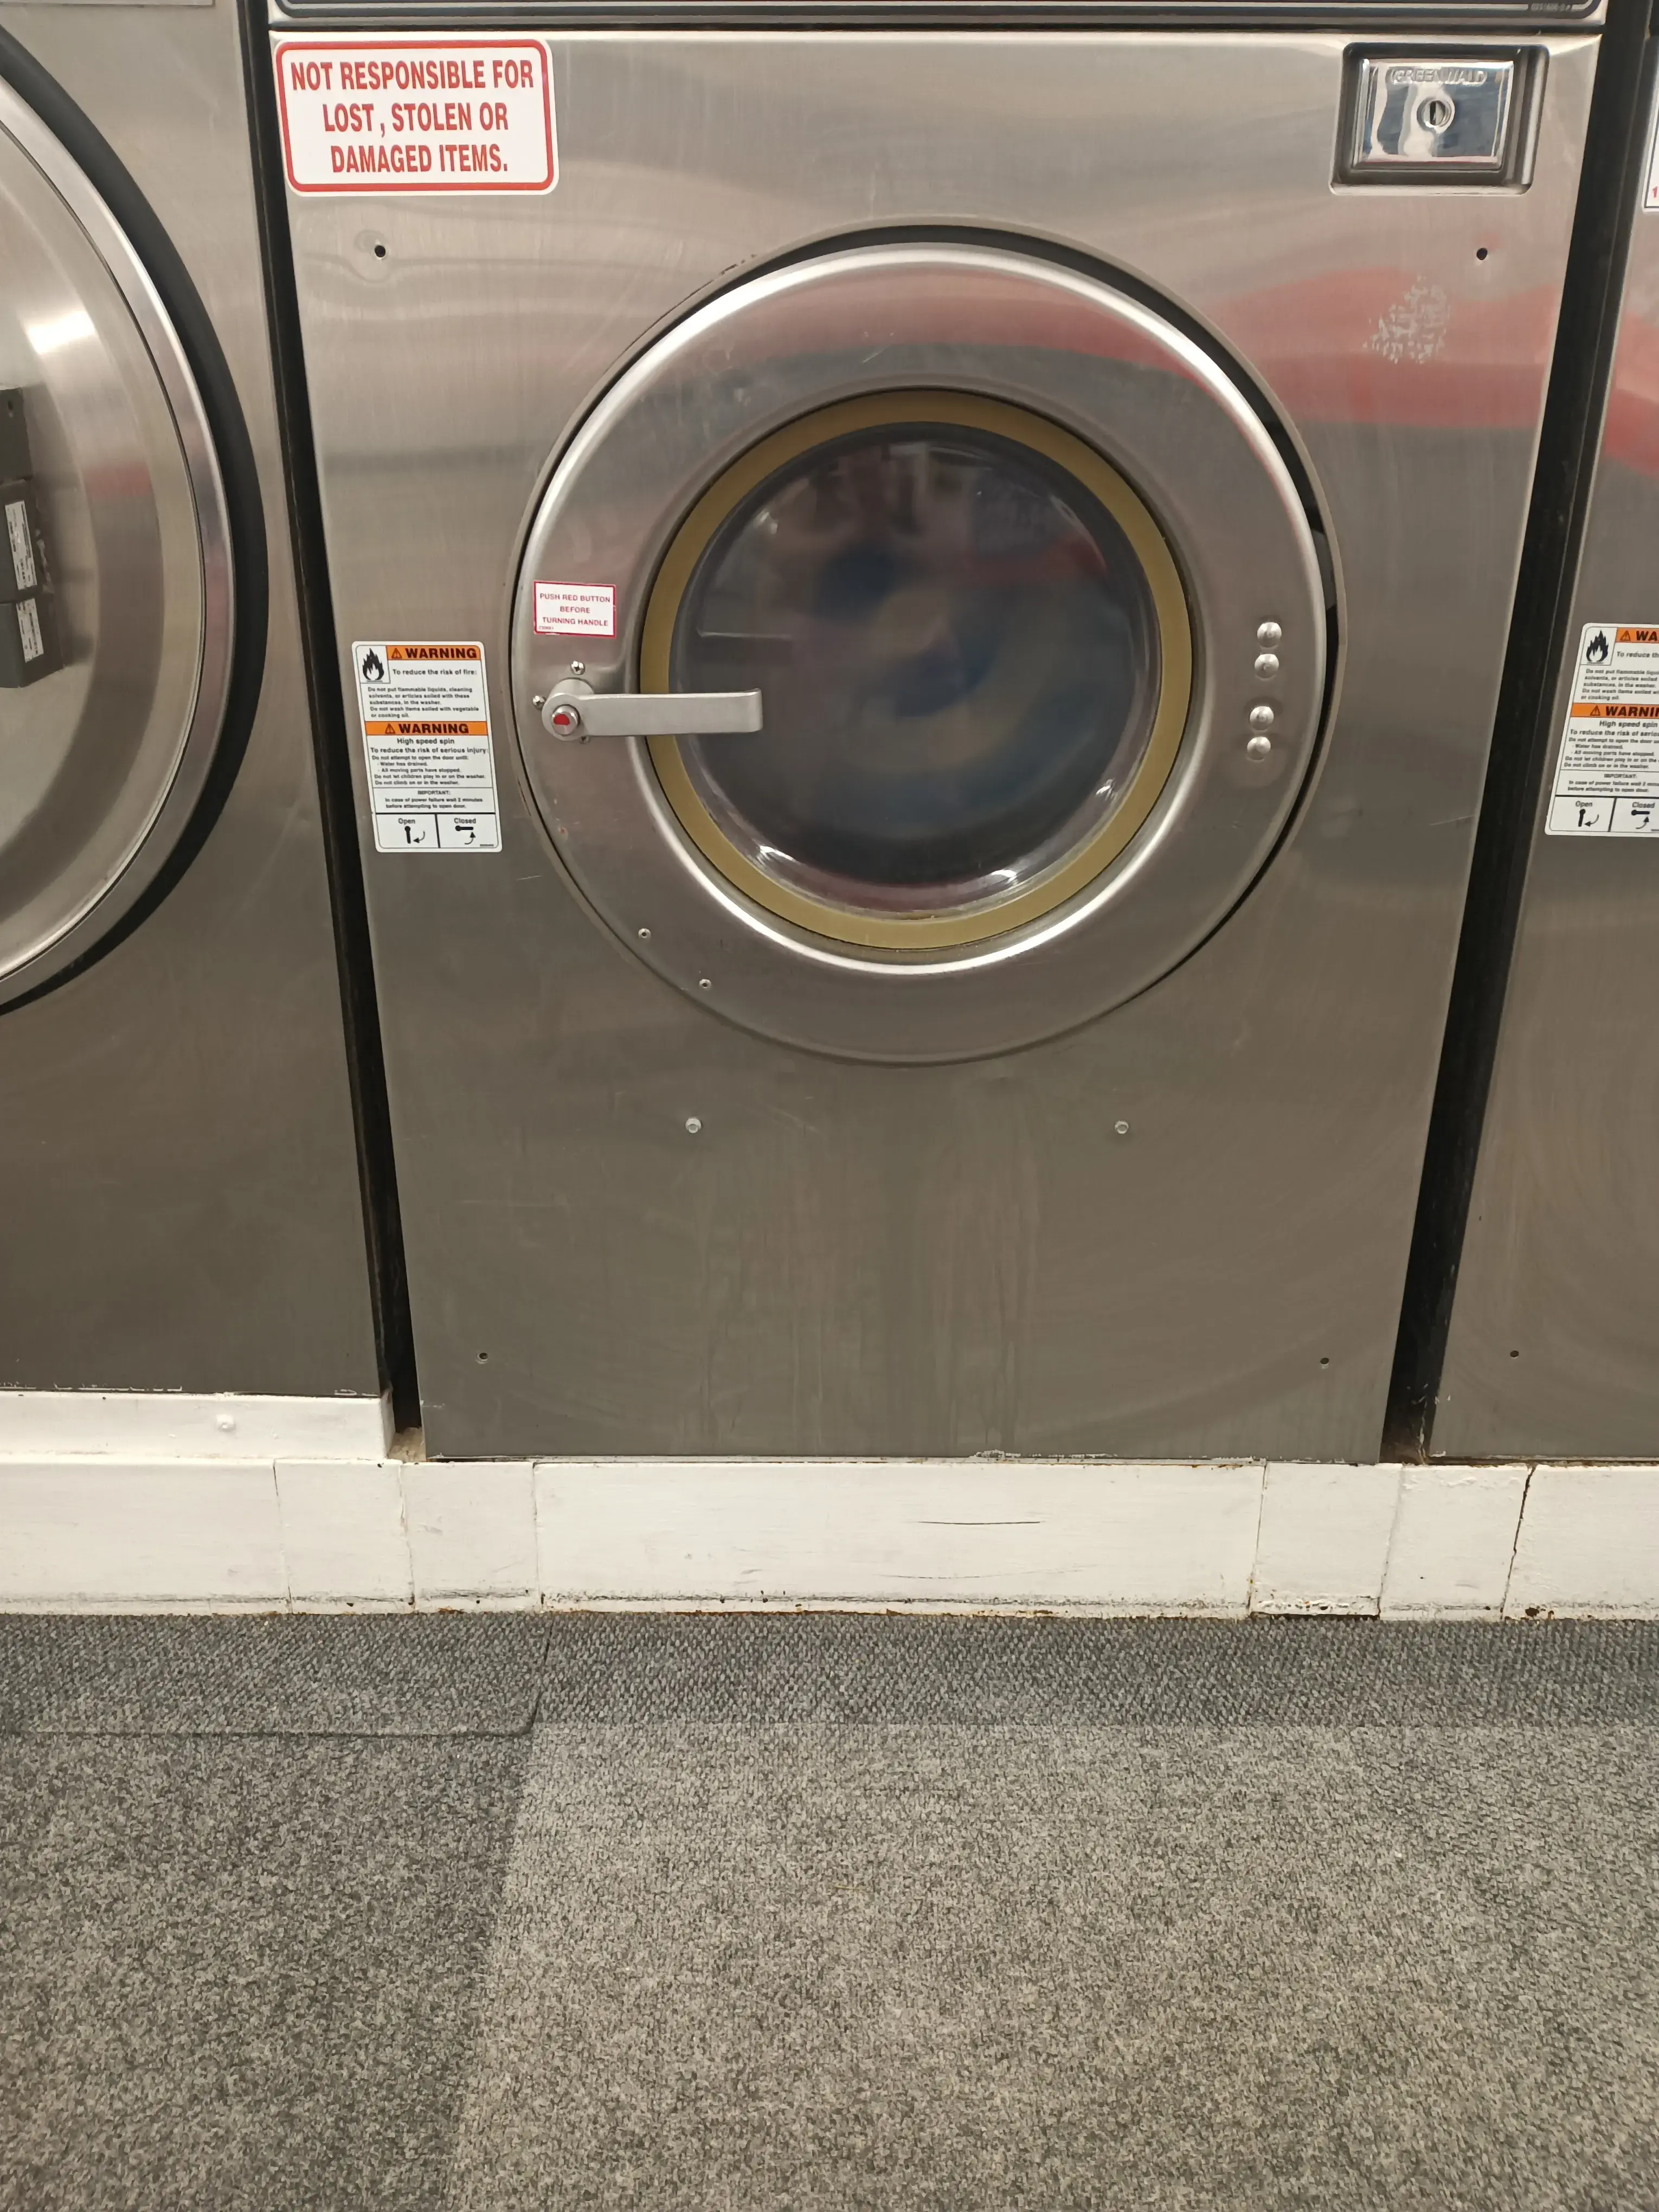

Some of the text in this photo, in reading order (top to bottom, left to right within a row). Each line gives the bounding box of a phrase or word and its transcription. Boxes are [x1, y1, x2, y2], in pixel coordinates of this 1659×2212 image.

[291, 60, 533, 91] NOT RESPONSIBLE FOR
[391, 102, 472, 132] STOLEN
[480, 102, 509, 131] OR
[331, 144, 507, 173] DAMAGED ITEMS.
[405, 648, 477, 659] WARNING
[398, 724, 469, 734] WARNING
